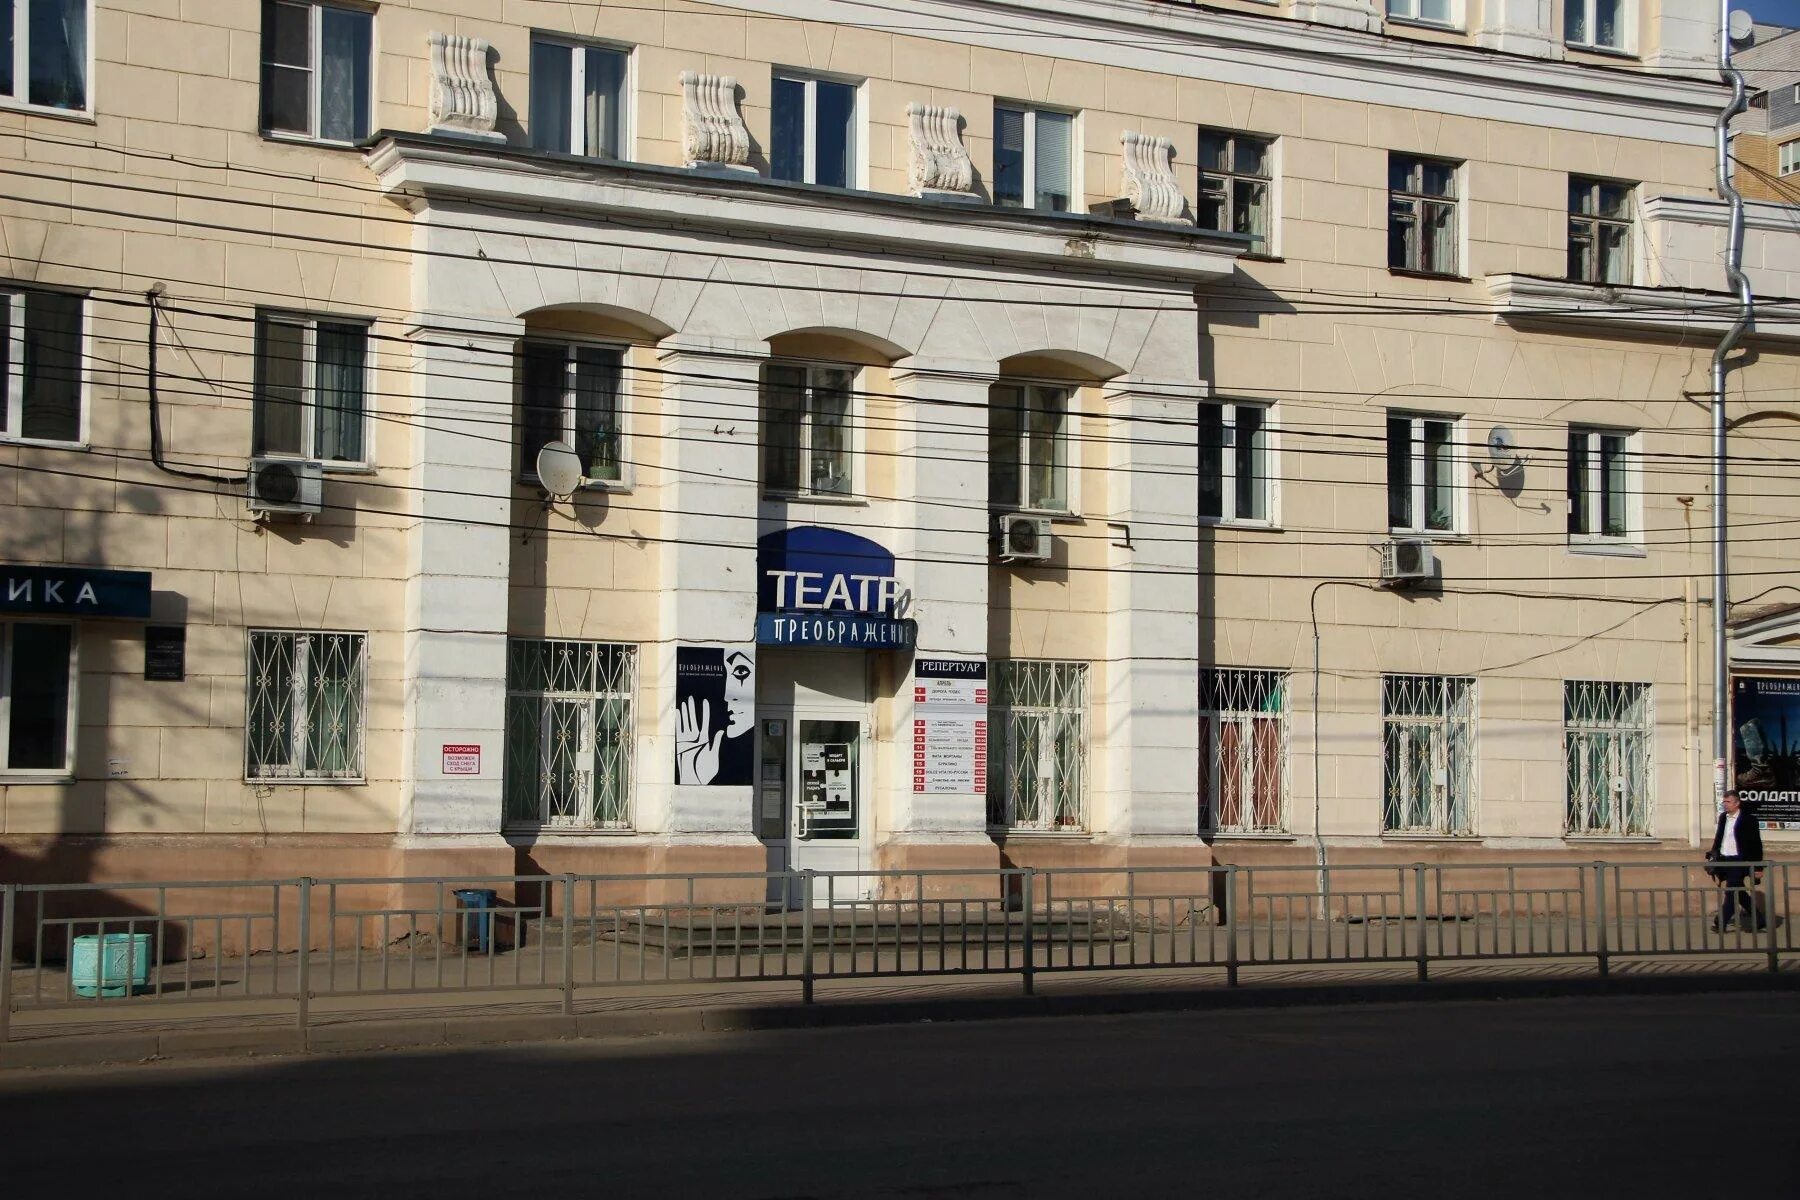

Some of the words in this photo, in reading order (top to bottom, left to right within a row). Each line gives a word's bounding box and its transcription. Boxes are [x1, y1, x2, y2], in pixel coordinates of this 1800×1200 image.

[8, 578, 99, 605] ИКА
[767, 570, 901, 613] ТЕАТР
[774, 619, 910, 645] ПРЕОБРАЖЕНИЕ
[922, 661, 980, 672] РЕПЕРТУАР
[1739, 791, 1800, 802] СОЛДАТ
